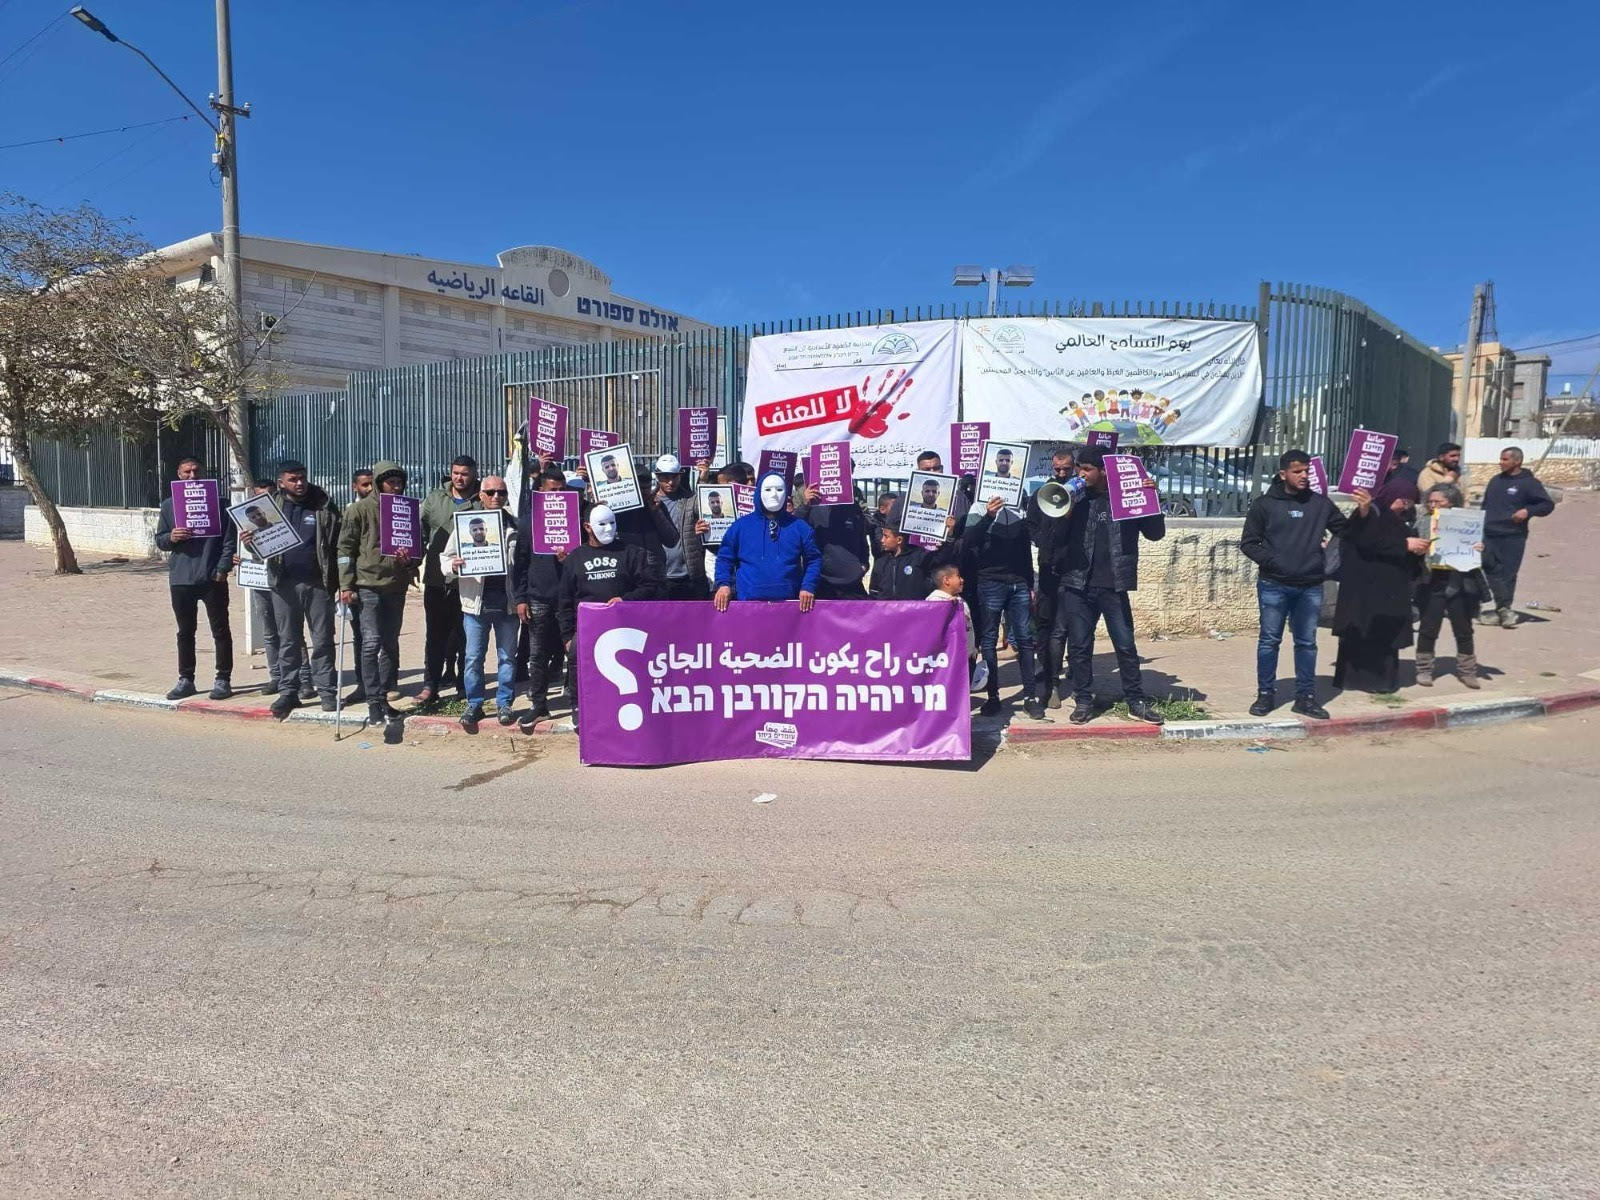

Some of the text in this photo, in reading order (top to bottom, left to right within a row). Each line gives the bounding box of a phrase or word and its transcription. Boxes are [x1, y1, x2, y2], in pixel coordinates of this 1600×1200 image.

[427, 270, 544, 306] القاعه الرياضيه
[577, 296, 679, 332] אולם ספורט
[1055, 334, 1192, 354] يوم التسامح العالمي
[762, 389, 851, 427] لا للعنف
[584, 557, 618, 571] BOSS
[648, 643, 712, 684] الجاي
[719, 642, 802, 674] الضحية
[809, 642, 859, 676] يكون
[865, 642, 900, 678] راح
[906, 652, 949, 675] مين
[651, 684, 947, 718] מי יהיה הקורבן הבא
